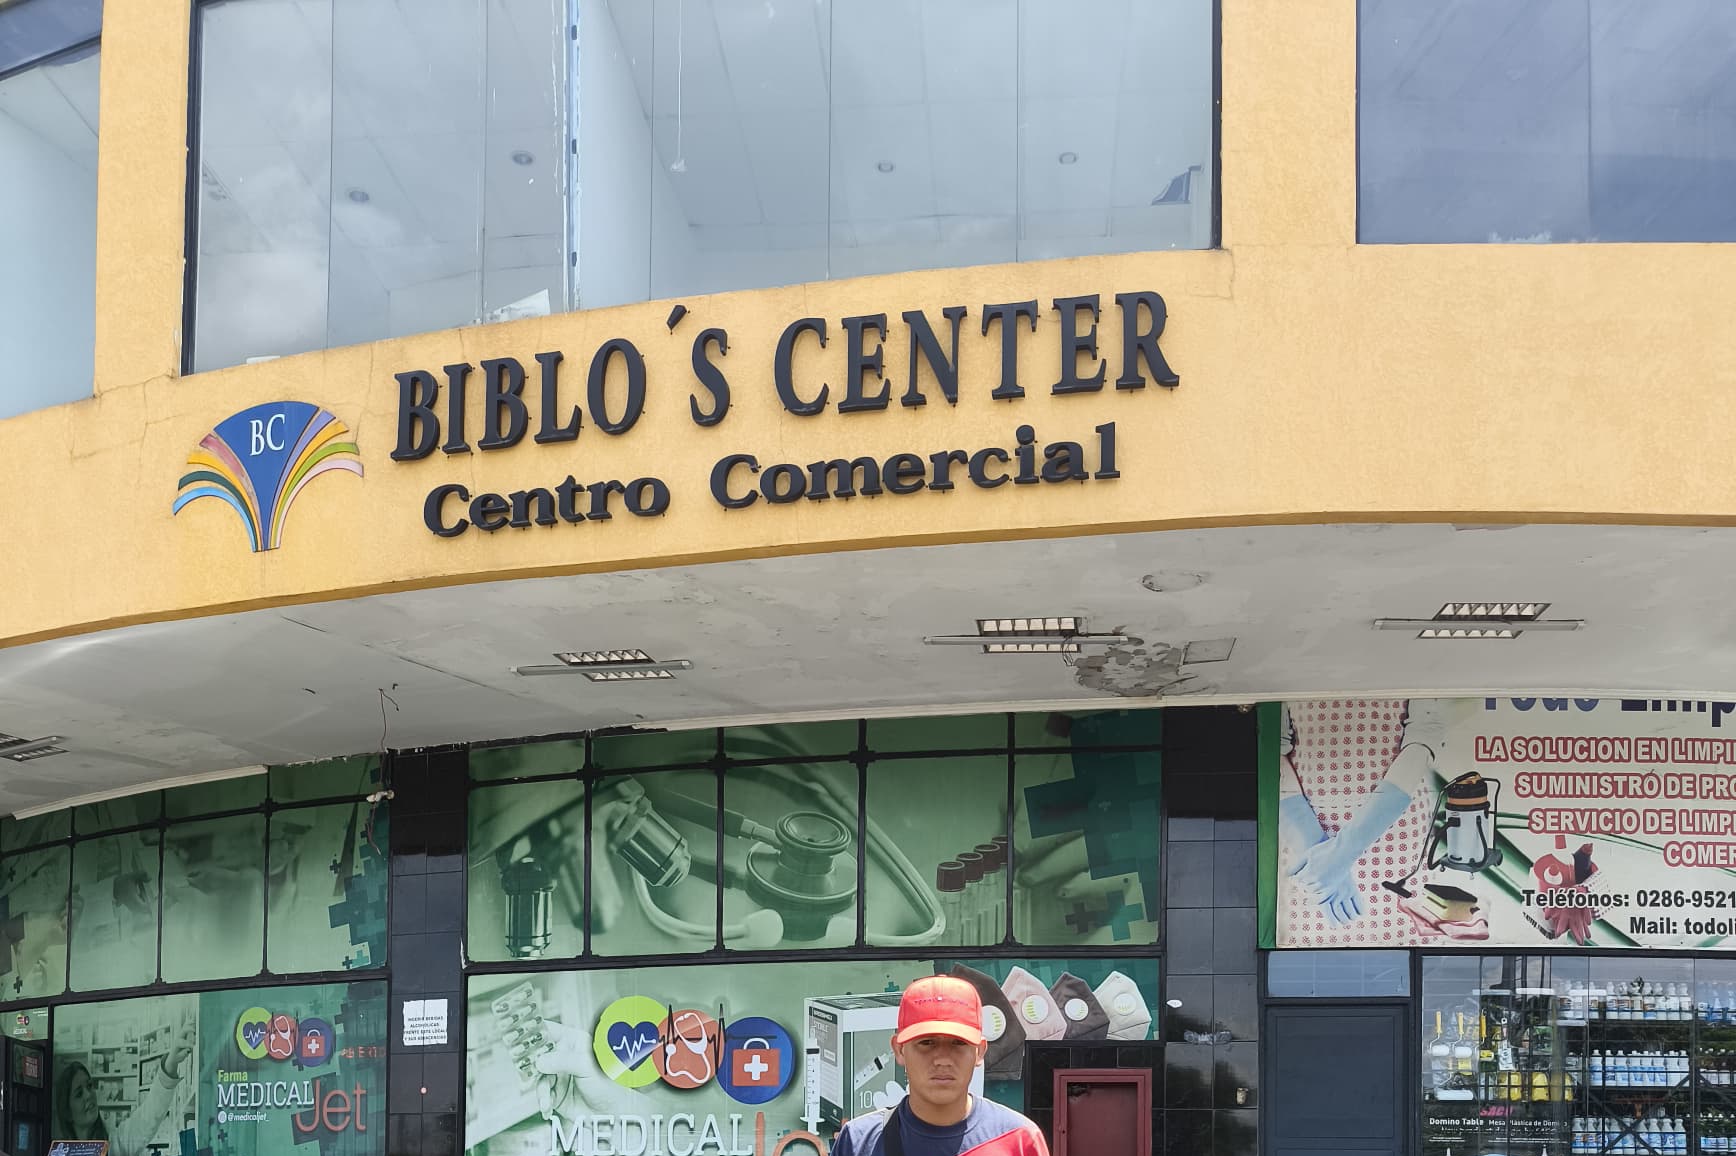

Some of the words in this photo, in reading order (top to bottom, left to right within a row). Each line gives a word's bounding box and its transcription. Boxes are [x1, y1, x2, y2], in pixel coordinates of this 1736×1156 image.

[773, 290, 1180, 417] CENTER
[249, 413, 286, 456] BC
[423, 475, 671, 538] Centro
[709, 421, 1121, 509] Comercial
[1475, 735, 1508, 763] LA
[1510, 736, 1631, 764] SOLUCION
[1634, 737, 1668, 764] EN
[1671, 737, 1736, 765] LIMPI
[1664, 773, 1697, 800] DE
[1528, 808, 1641, 834] SERVICIO
[1643, 809, 1676, 835] DE
[1522, 888, 1629, 907] Teléfonos:
[1636, 890, 1736, 908] 0286-9521
[1630, 916, 1677, 935] Mail:
[217, 1069, 248, 1083] Farma
[217, 1080, 314, 1108] MEDICAL
[295, 1079, 367, 1133] Jet
[550, 1112, 754, 1156] MEDICAL
[1429, 1117, 1460, 1126] Domino
